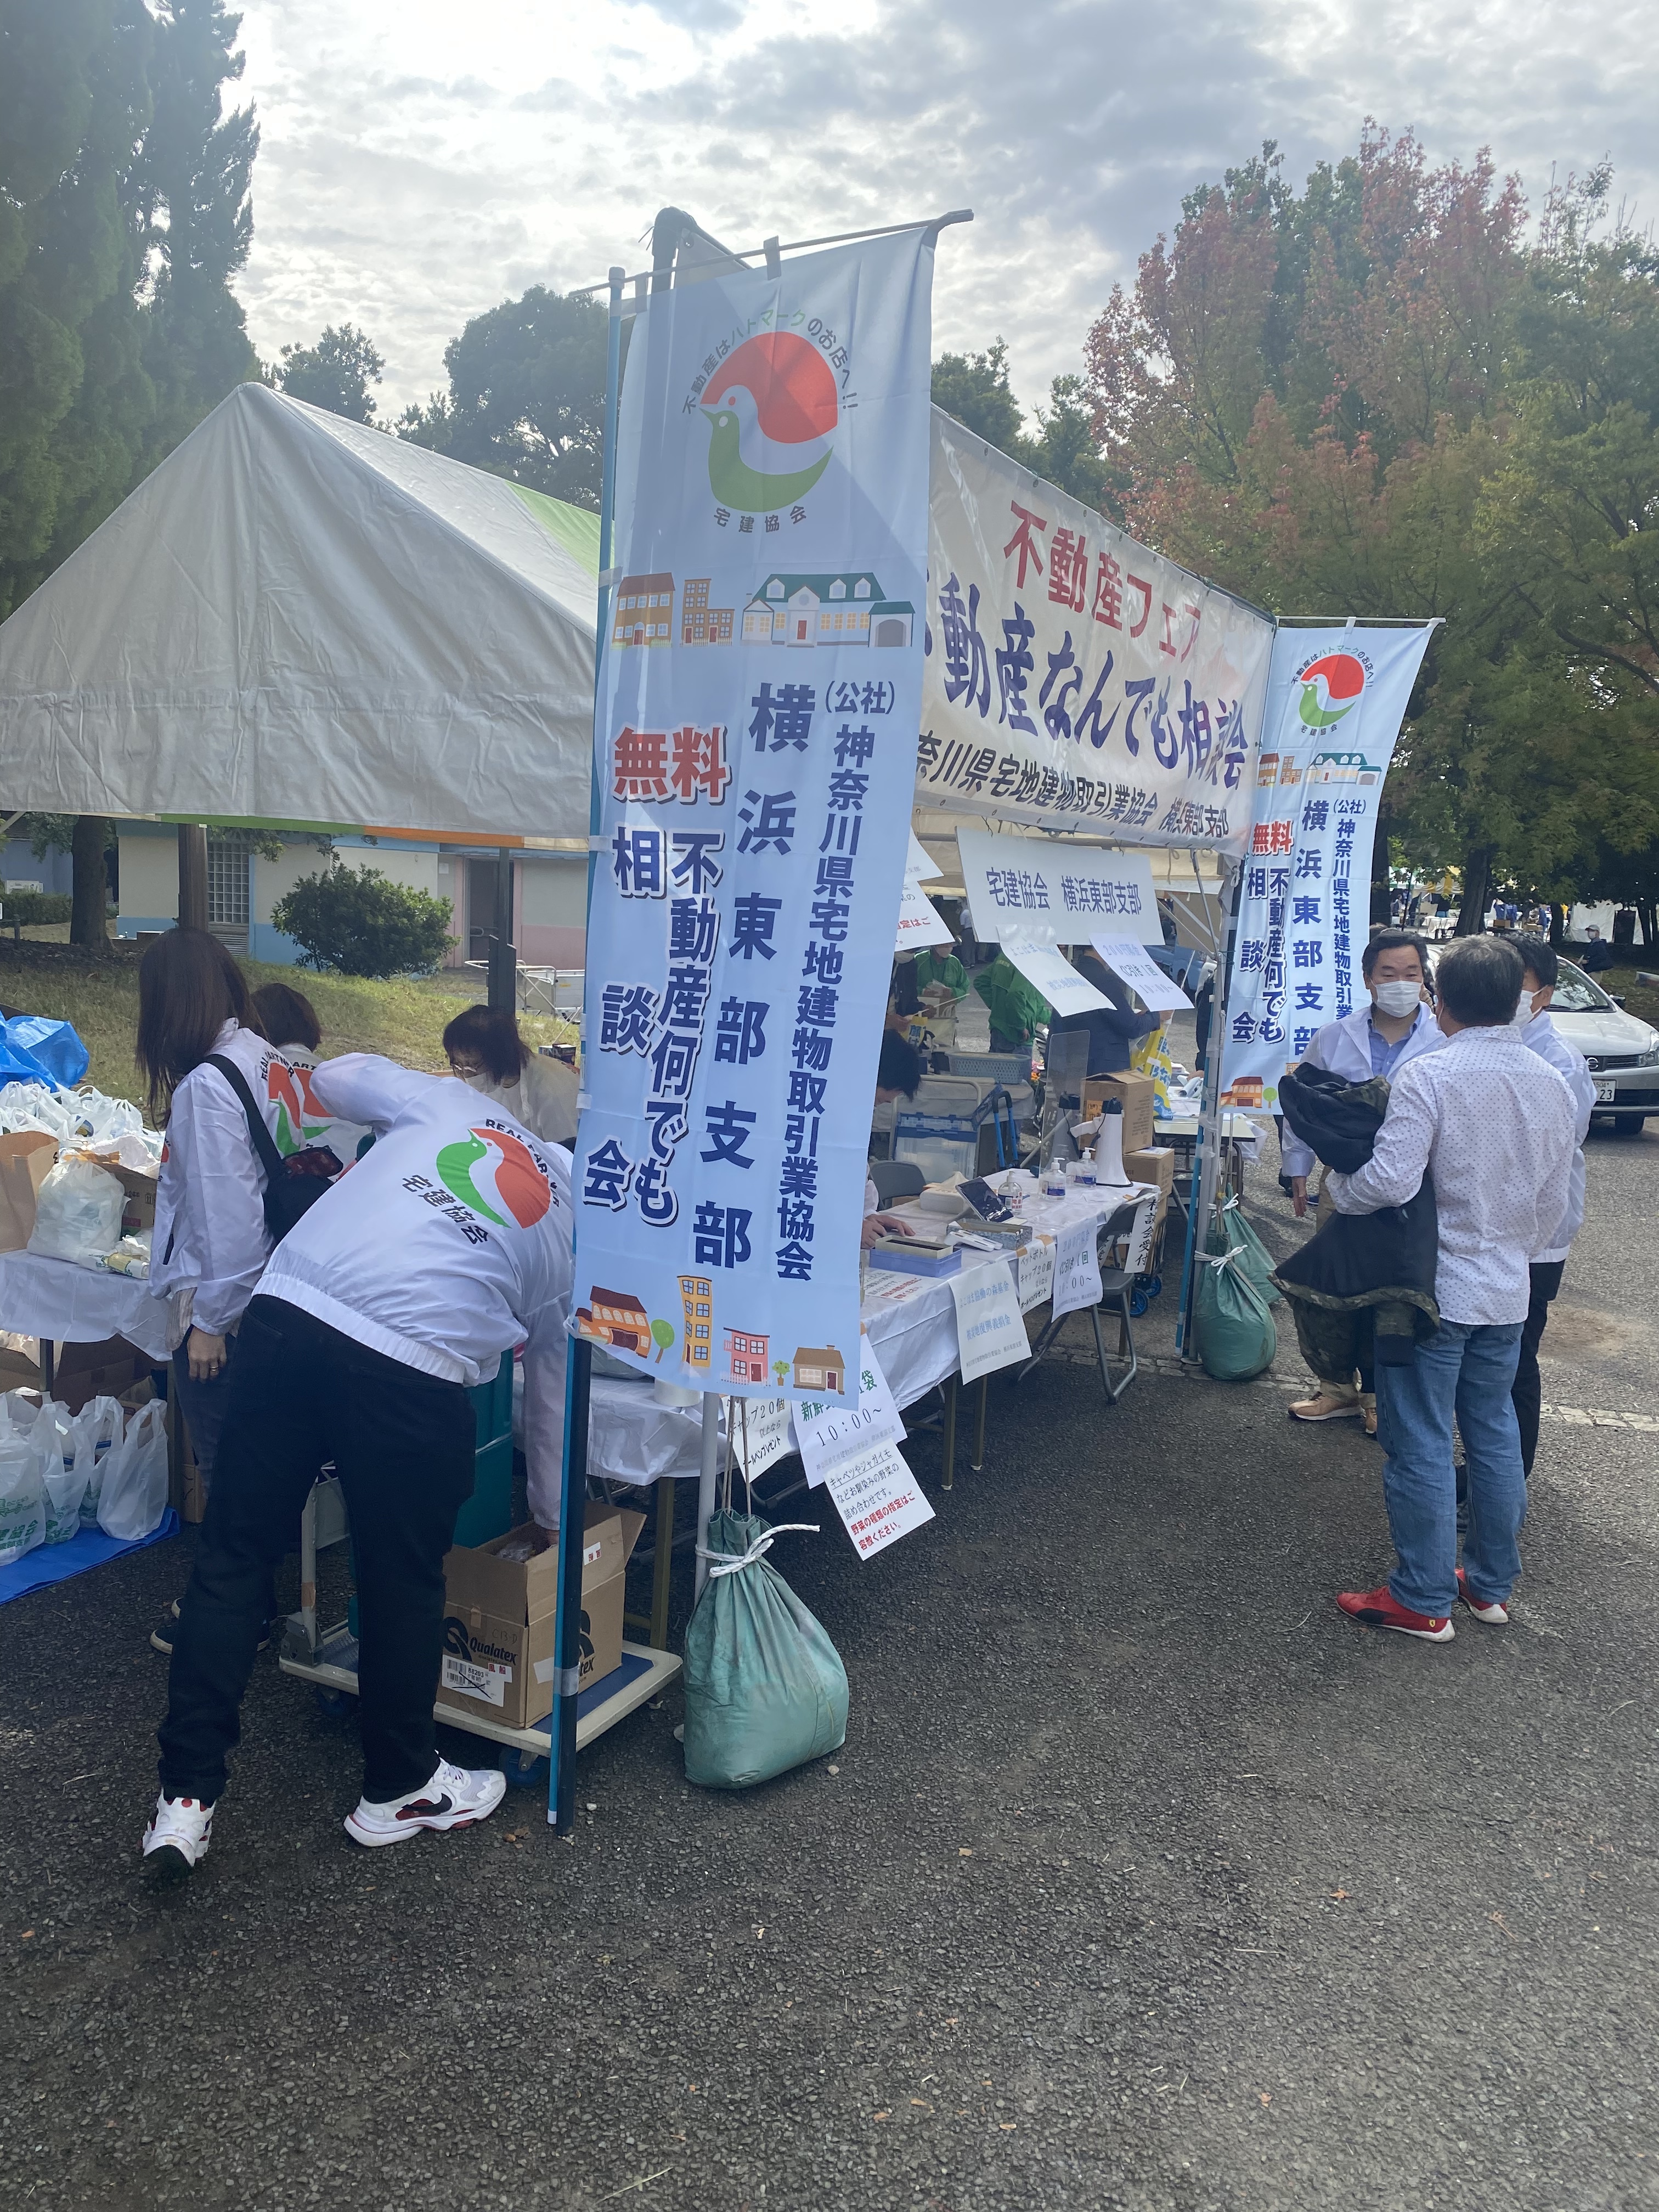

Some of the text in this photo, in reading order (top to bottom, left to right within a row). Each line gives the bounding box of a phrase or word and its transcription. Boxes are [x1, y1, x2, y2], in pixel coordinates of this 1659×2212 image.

[714, 505, 808, 533] 宅建協会
[1003, 500, 1201, 663] 不動産フェア
[826, 681, 895, 714] (公社)
[1301, 724, 1338, 736] 宅建協会
[613, 726, 726, 798] 無料
[1333, 799, 1367, 814] (公社)
[1252, 821, 1293, 854] 無料
[986, 866, 1142, 915] 宅建協会 横浜東部支部
[693, 682, 816, 1269] 横浜東部支部
[1232, 867, 1268, 1041] 相談会
[1261, 867, 1289, 1042] 不動産何でも
[583, 827, 660, 1205] 相談会
[775, 724, 876, 1282] 神奈川県宅地建物取引業協会
[633, 833, 721, 1222] 不動産何でも
[1600, 1090, 1612, 1100] 23
[486, 1118, 524, 1143] REAL
[402, 1175, 489, 1245] 宅建協会
[830, 1448, 893, 1488] キャベツやジャガイモ
[836, 1463, 900, 1504] などお馴染みの野菜の
[850, 1489, 916, 1536] 野菜の種類の指定はご
[470, 1637, 518, 1666] Qualatex
